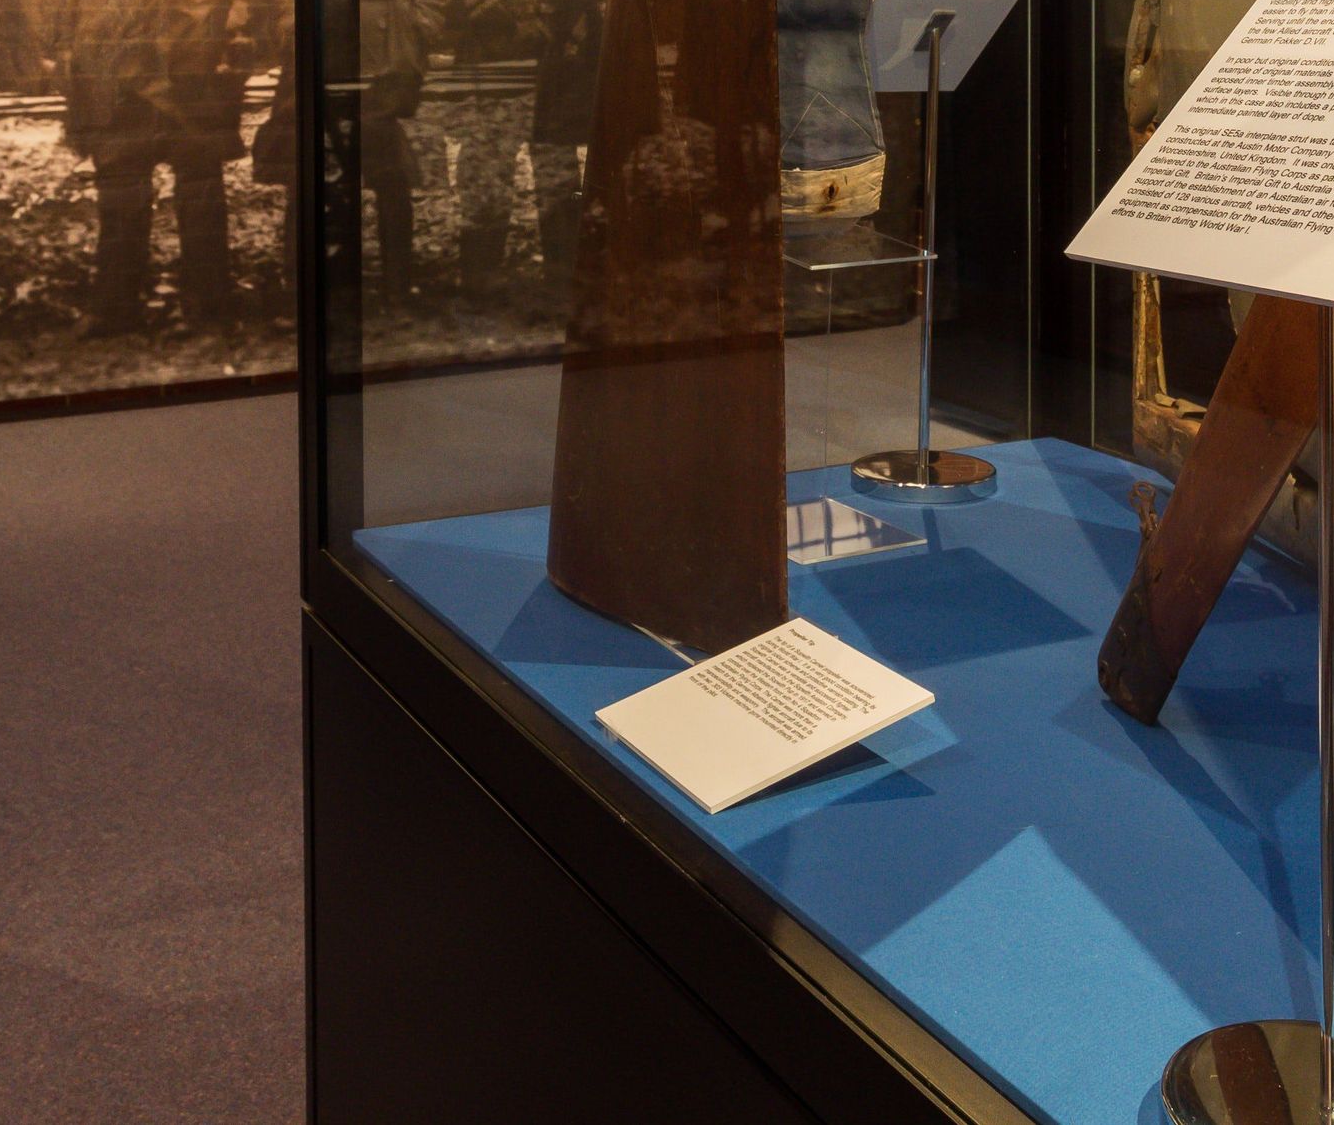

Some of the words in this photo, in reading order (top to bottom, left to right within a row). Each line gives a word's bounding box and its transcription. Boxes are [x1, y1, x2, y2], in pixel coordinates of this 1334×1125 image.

[1241, 36, 1273, 44] German
[1274, 37, 1303, 45] Fokker
[1188, 106, 1237, 115] intermediate
[1236, 109, 1270, 118] painted
[1269, 110, 1292, 120] layer
[1302, 113, 1325, 122] dope.
[1174, 125, 1191, 134] This
[1191, 127, 1222, 137] original
[1221, 129, 1244, 138] SE5a
[1245, 131, 1287, 141] interplane
[1288, 135, 1309, 143] strut
[1166, 137, 1212, 146] constructed
[1221, 140, 1235, 149] the
[1235, 141, 1263, 150] Austin
[1263, 144, 1290, 153] Motor
[1291, 146, 1334, 159] Company
[1220, 151, 1249, 161] United
[1248, 154, 1286, 165] Kingdom.
[1143, 166, 1175, 176] Imperial
[1174, 169, 1190, 178] Gift.
[1228, 175, 1265, 186] Imperial
[1264, 179, 1281, 188] Gift
[1291, 182, 1332, 194] Australia
[1150, 156, 1187, 166] delivered
[1195, 160, 1210, 169] the
[1209, 162, 1252, 173] Australian
[1252, 166, 1280, 178] Flying
[1281, 169, 1308, 180] Corps
[1127, 188, 1165, 198] consisted
[1175, 192, 1191, 201] 128
[1191, 196, 1221, 205] various
[1221, 199, 1252, 210] aircraft,
[1256, 204, 1291, 214] vehicles
[1292, 208, 1313, 217] and
[1135, 177, 1165, 186] support
[1174, 181, 1188, 189] the
[1188, 184, 1246, 196] establishment
[1269, 192, 1314, 204] Australian
[1315, 198, 1330, 206] air
[1111, 208, 1136, 217] efforts
[1145, 212, 1171, 222] Britain
[1172, 216, 1198, 228] during
[1199, 219, 1226, 230] World
[1225, 223, 1245, 233] War
[1119, 198, 1160, 209] equipment
[1171, 205, 1228, 218] compensation
[1228, 211, 1242, 220] for
[1242, 214, 1257, 223] the
[1258, 216, 1303, 228] Australian
[1304, 221, 1333, 234] Flying
